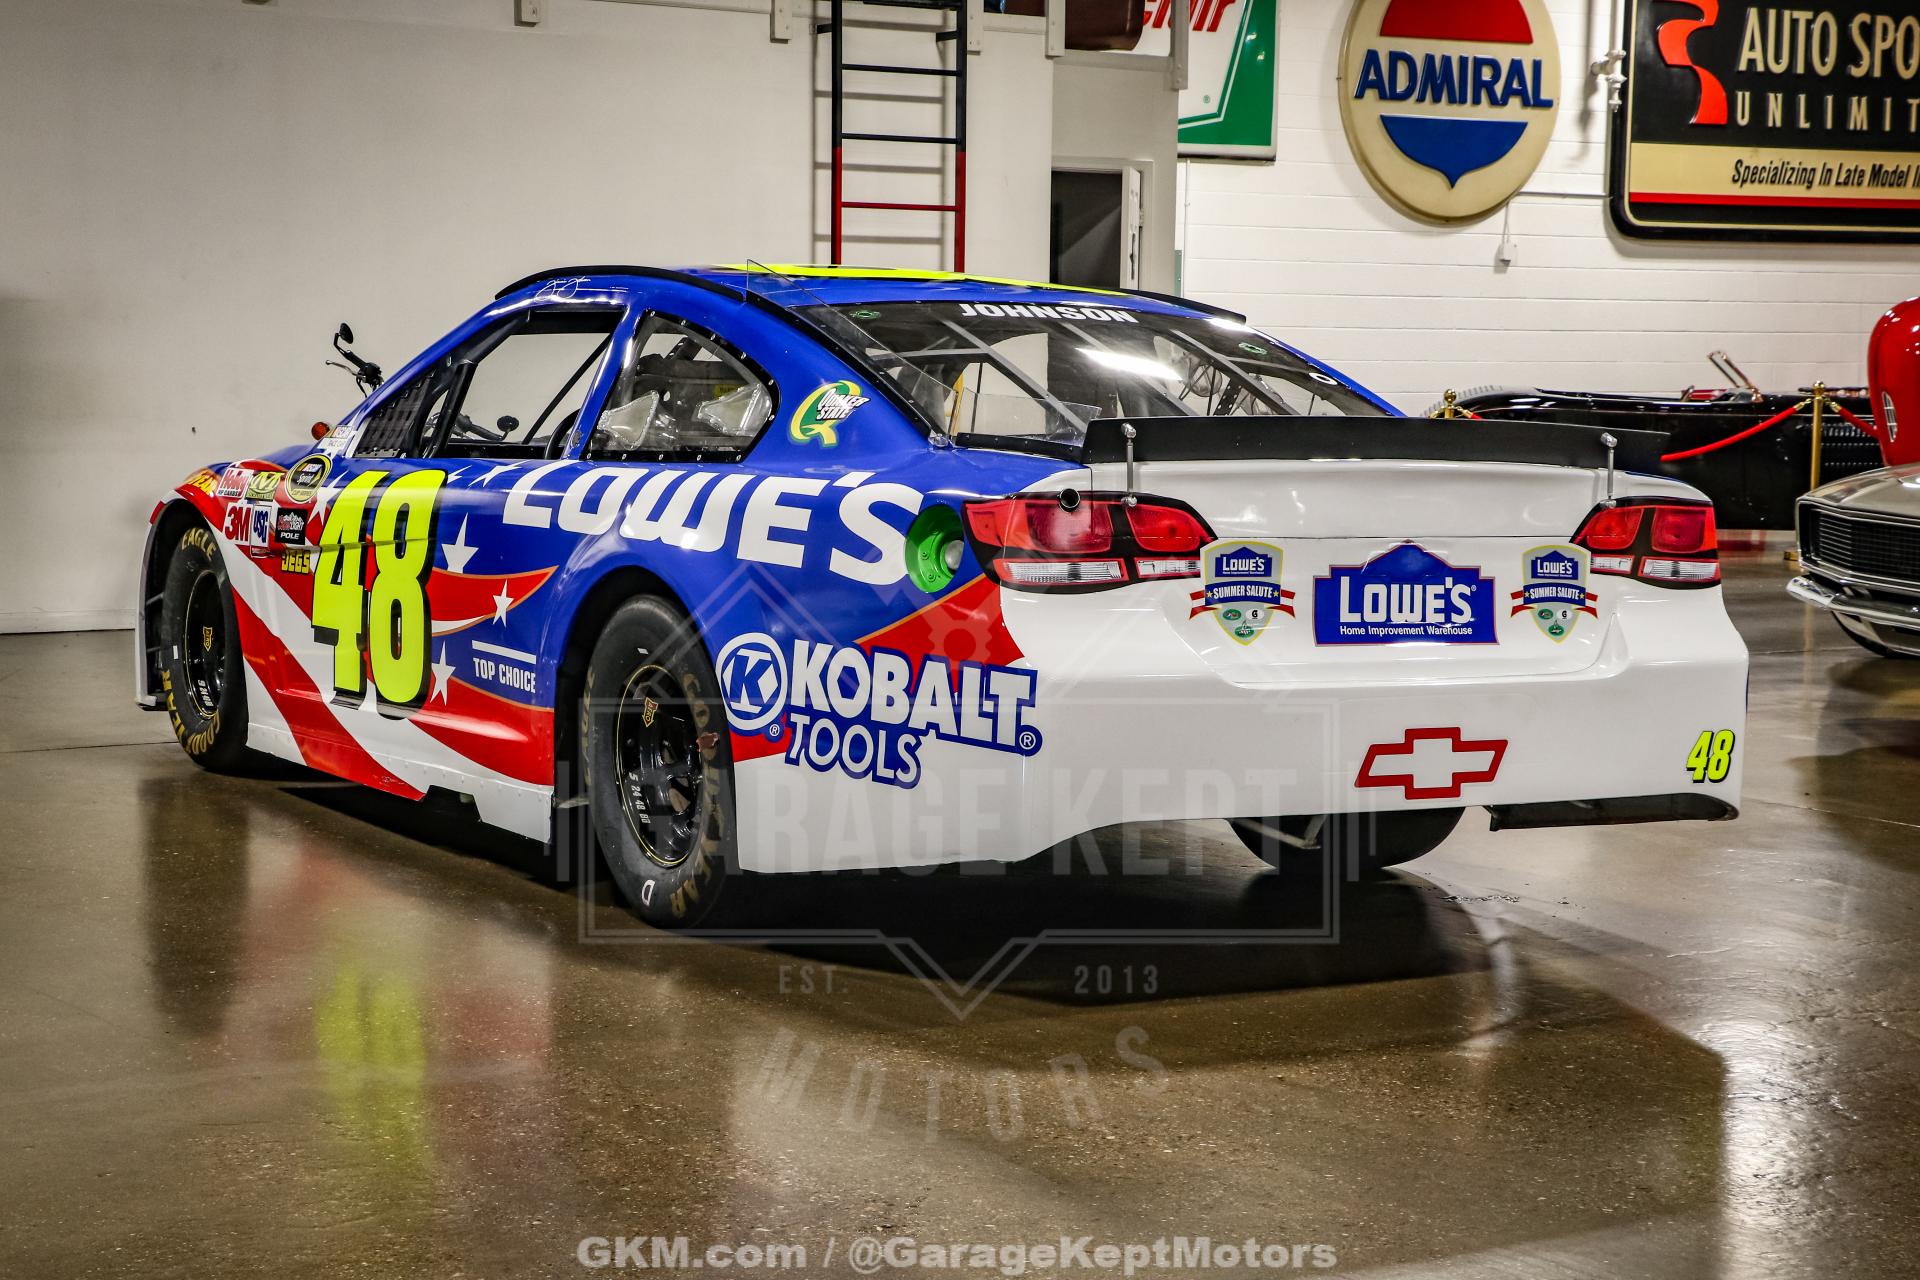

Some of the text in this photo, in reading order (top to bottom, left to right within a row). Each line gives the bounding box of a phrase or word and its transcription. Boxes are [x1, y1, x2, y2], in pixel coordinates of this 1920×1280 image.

[1737, 7, 1838, 77] AUTO
[1354, 48, 1554, 108] ADMIRAL
[1732, 158, 1817, 190] Specializing
[1819, 162, 1834, 187] In
[1835, 163, 1866, 187] Late
[1867, 164, 1911, 188] Model
[959, 303, 1139, 324] JOHNSON
[224, 505, 252, 542] 3M
[280, 532, 300, 540] POLE
[503, 459, 925, 586] LOWE'S
[181, 526, 217, 562] EAGLE
[281, 549, 311, 574] JEGS
[1222, 556, 1265, 572] LOWE'S
[1537, 559, 1573, 575] LOWE'S
[312, 469, 447, 716] 48
[1213, 584, 1274, 600] SUMMER SALUTE
[1339, 576, 1473, 624] LOWE'S
[1529, 586, 1581, 600] SUMMER SALUTE
[1339, 625, 1473, 637] Home Improvement Warehouse
[473, 657, 536, 694] TOP CHOICE
[791, 639, 1032, 747] KOBALT
[788, 712, 921, 784] TOOLS
[1686, 729, 1736, 784] 48
